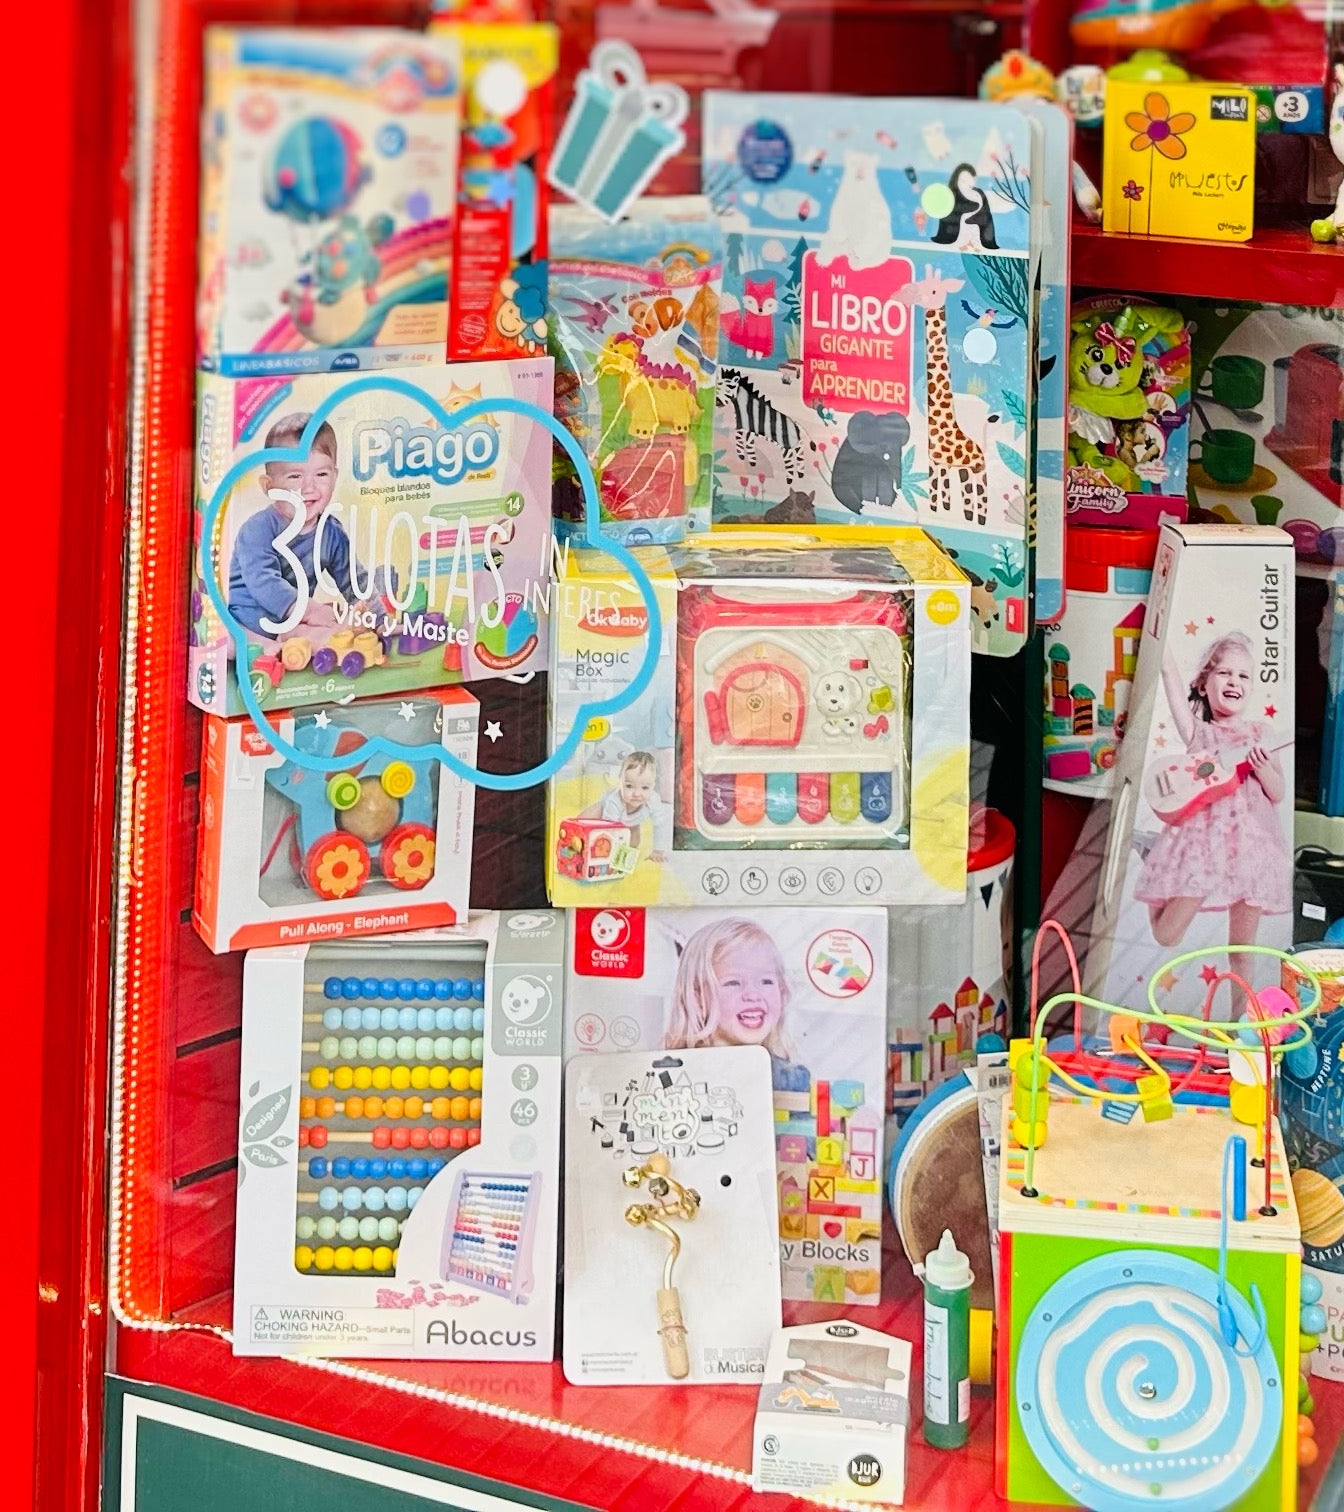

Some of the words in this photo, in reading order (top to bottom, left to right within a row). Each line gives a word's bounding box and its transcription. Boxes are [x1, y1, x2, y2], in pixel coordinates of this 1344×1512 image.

[1283, 96, 1299, 113] +3
[831, 274, 846, 289] MI
[811, 291, 907, 336] LIBRO
[820, 334, 894, 361] GIGANTE
[810, 358, 838, 376] para
[809, 377, 906, 406] APRENDER
[359, 425, 494, 479] Piago
[360, 484, 396, 496] Bloques
[385, 494, 404, 504] para
[405, 491, 431, 501] bebés
[507, 497, 522, 512] 14
[260, 489, 308, 634] 3
[314, 502, 508, 630] CUOTAS
[1261, 563, 1279, 630] Guitar
[333, 601, 377, 630] Visa
[382, 614, 398, 637] y
[575, 648, 630, 665] Magic
[1261, 634, 1279, 684] Star
[575, 665, 603, 677] Box
[252, 678, 264, 697] 4
[280, 926, 304, 939] Pull
[307, 921, 344, 936] Along
[354, 912, 409, 931] Elephant
[591, 949, 629, 962] Classic
[505, 1026, 548, 1039] Classic
[505, 1037, 545, 1047] WORLD
[520, 1067, 530, 1079] 3
[1311, 1048, 1333, 1094] NEPTUNE
[246, 1092, 286, 1137] Designed
[513, 1103, 535, 1117] 46
[250, 1148, 279, 1166] Paris
[802, 1241, 870, 1263] Blocks
[280, 1310, 344, 1321] WARNING
[254, 1321, 309, 1332] CHOKING
[426, 1319, 536, 1347] Abacus
[254, 1332, 266, 1340] Not
[269, 1332, 280, 1340] for
[282, 1332, 313, 1341] children
[718, 1362, 765, 1374] Musica
